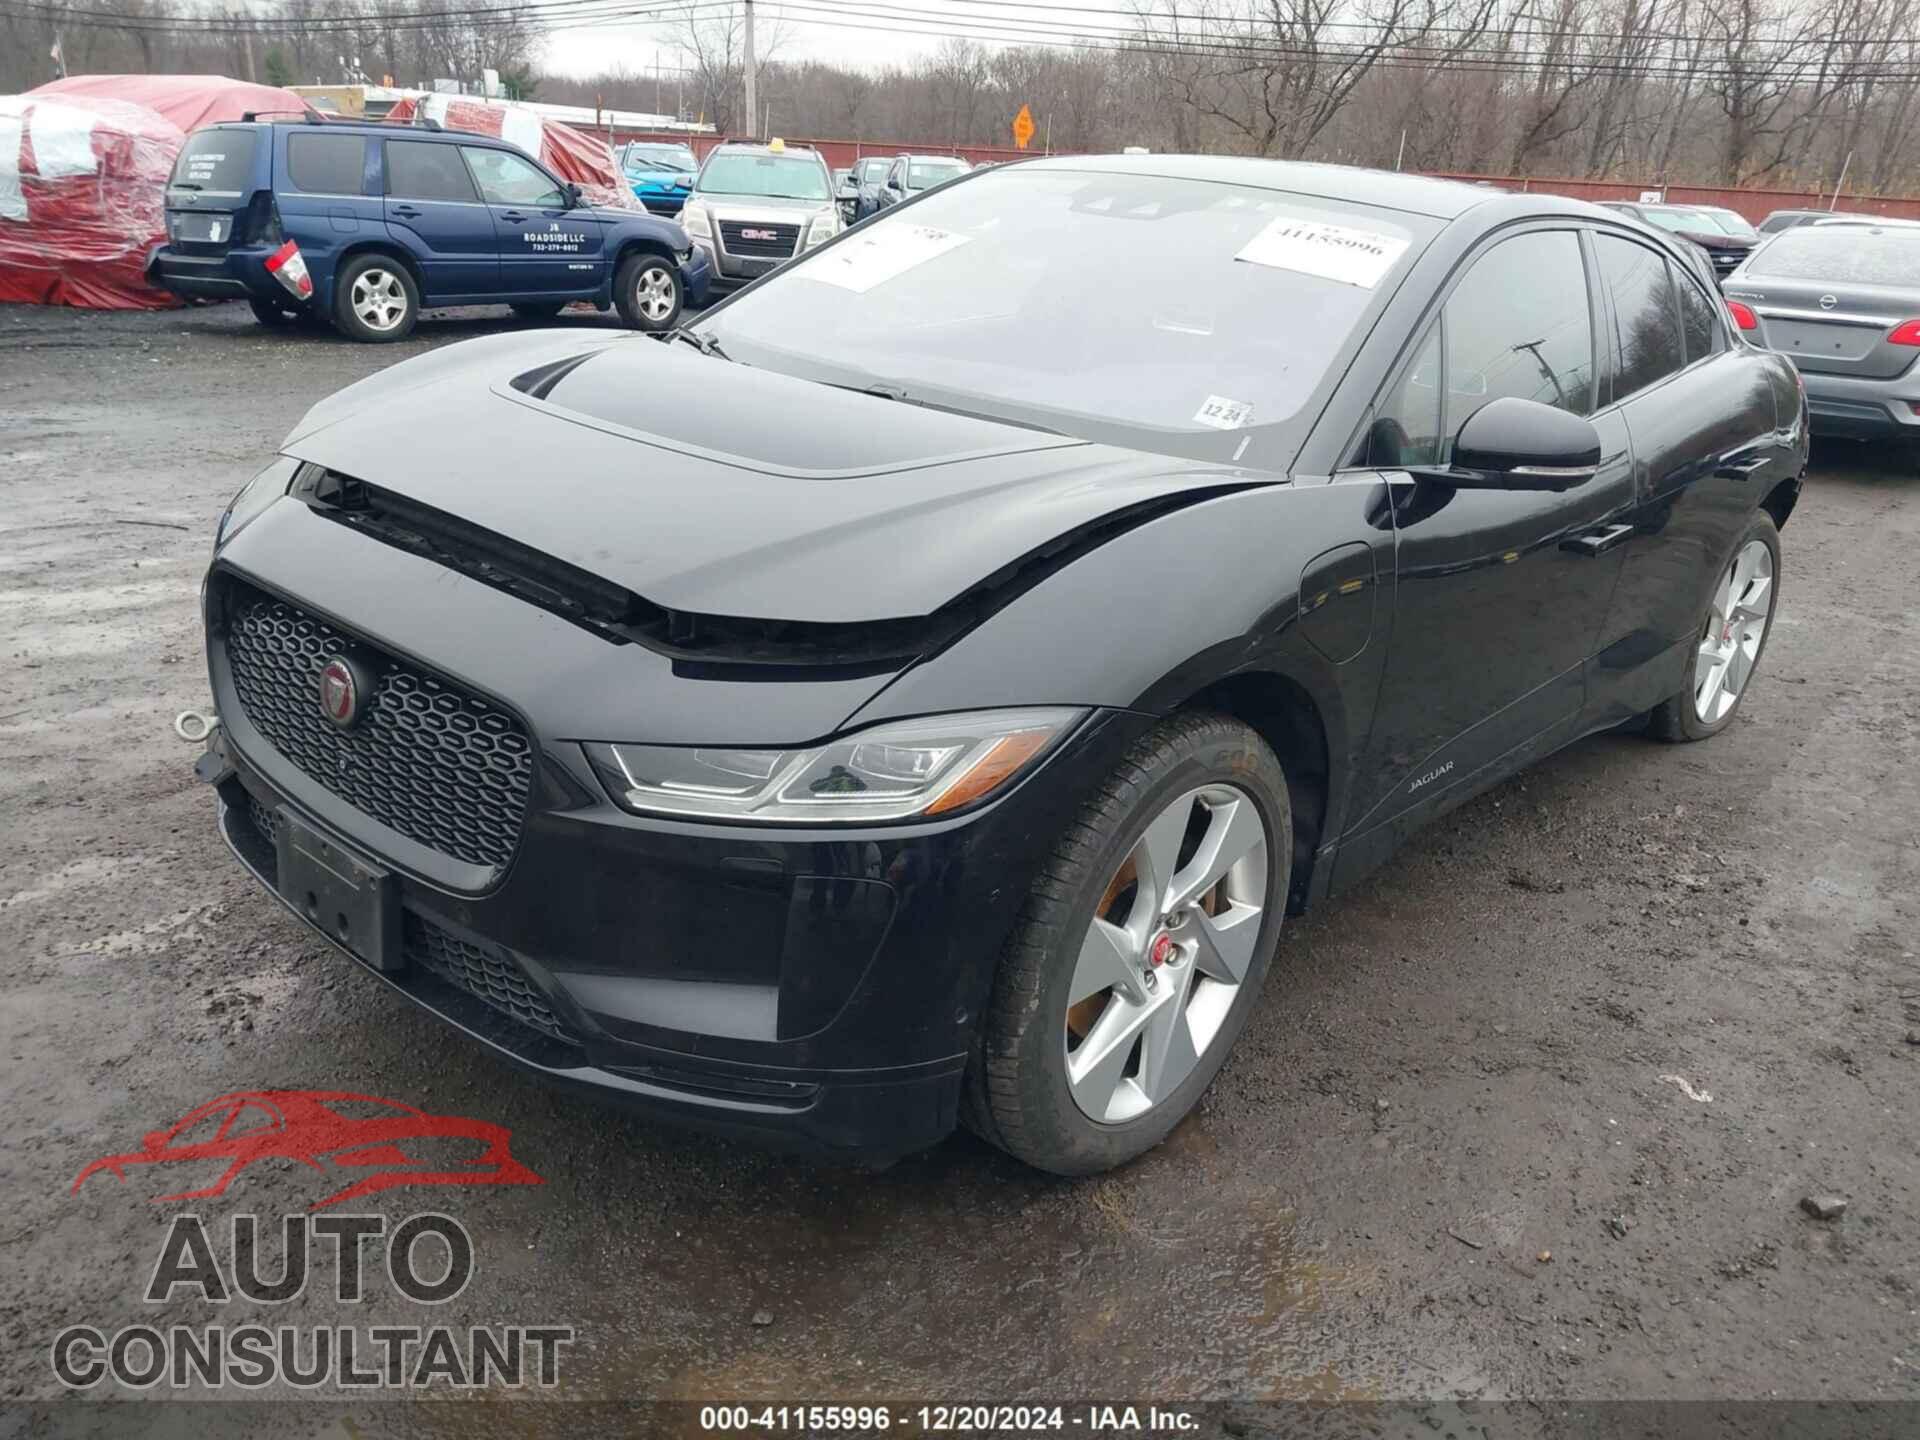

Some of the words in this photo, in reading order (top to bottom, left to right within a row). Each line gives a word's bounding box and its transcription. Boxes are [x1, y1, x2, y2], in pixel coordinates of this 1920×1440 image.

[524, 233, 569, 242] ROADSIDE
[569, 233, 585, 242] LLC
[741, 229, 777, 240] GMC
[1407, 760, 1455, 794] JAGUAR
